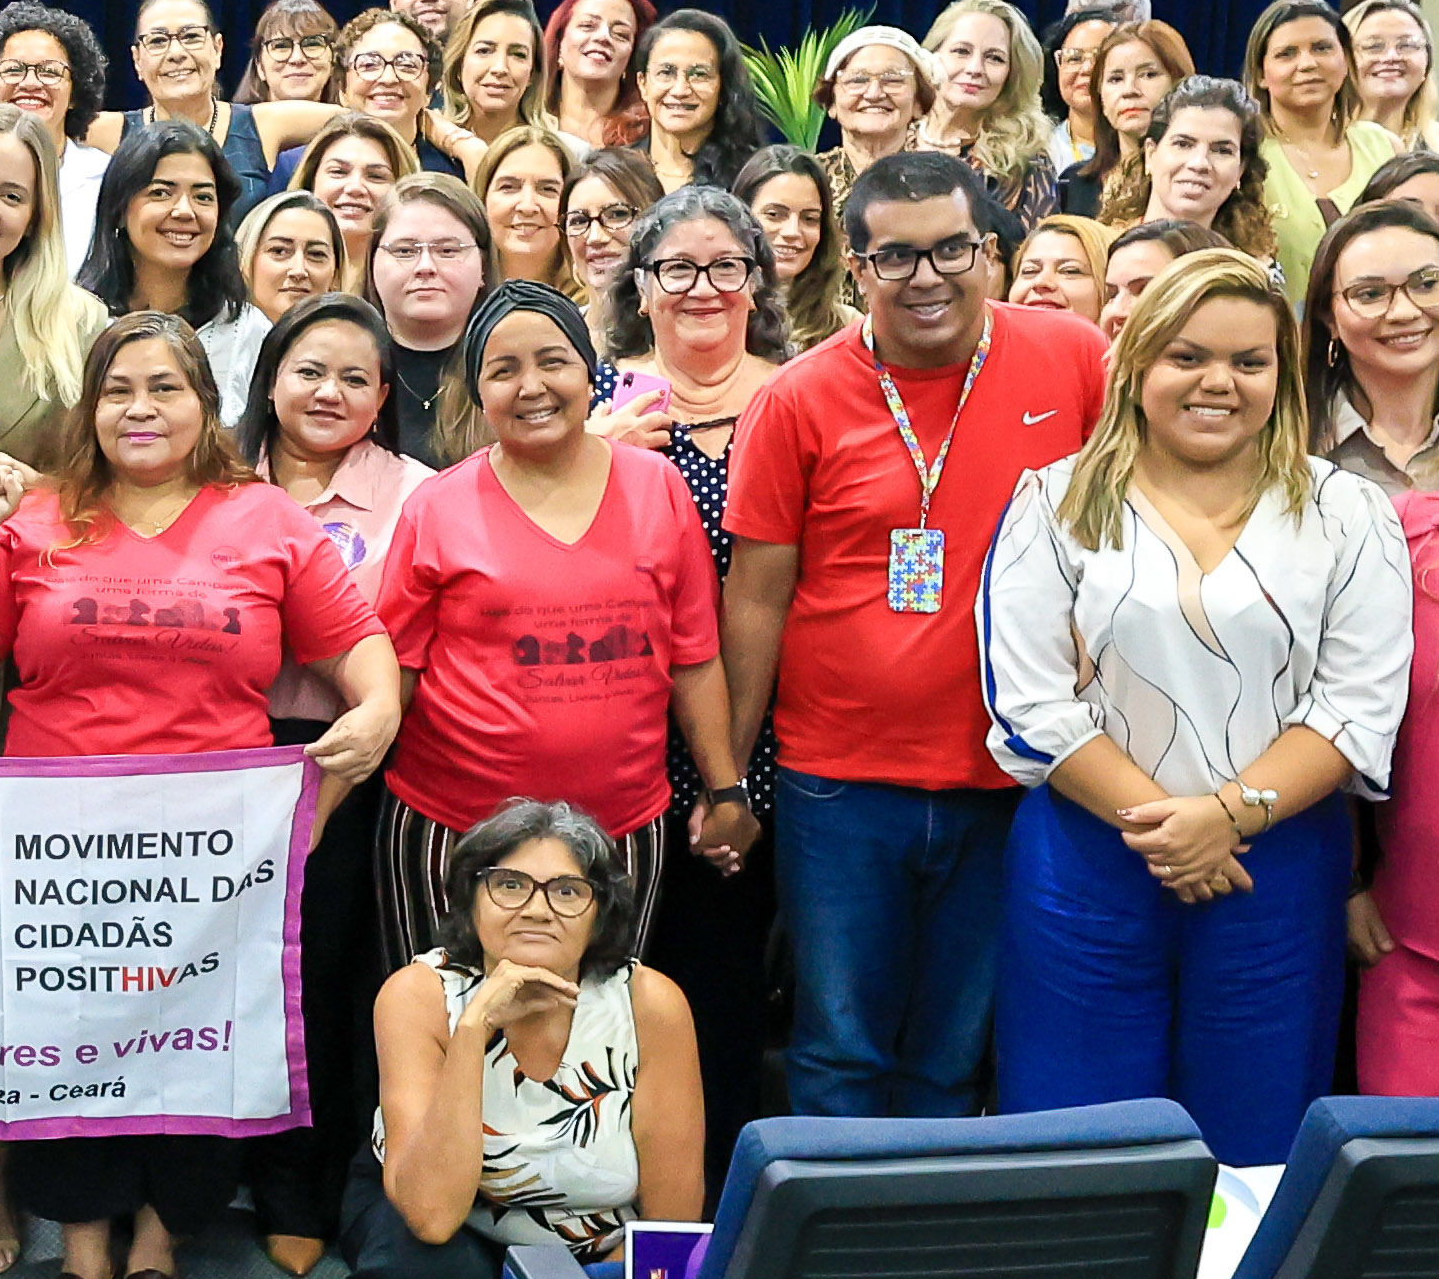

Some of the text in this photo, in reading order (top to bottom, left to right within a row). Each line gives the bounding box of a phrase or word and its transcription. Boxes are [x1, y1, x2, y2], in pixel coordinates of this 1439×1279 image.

[15, 829, 234, 860] MOVIMENTO
[14, 858, 275, 906] NACIONAL DAS
[14, 915, 173, 949] CIDADÃS
[15, 951, 221, 993] POSITHIVAS
[75, 1044, 98, 1064] e
[113, 1019, 232, 1059] vivas!
[48, 1076, 127, 1102] Ceará
